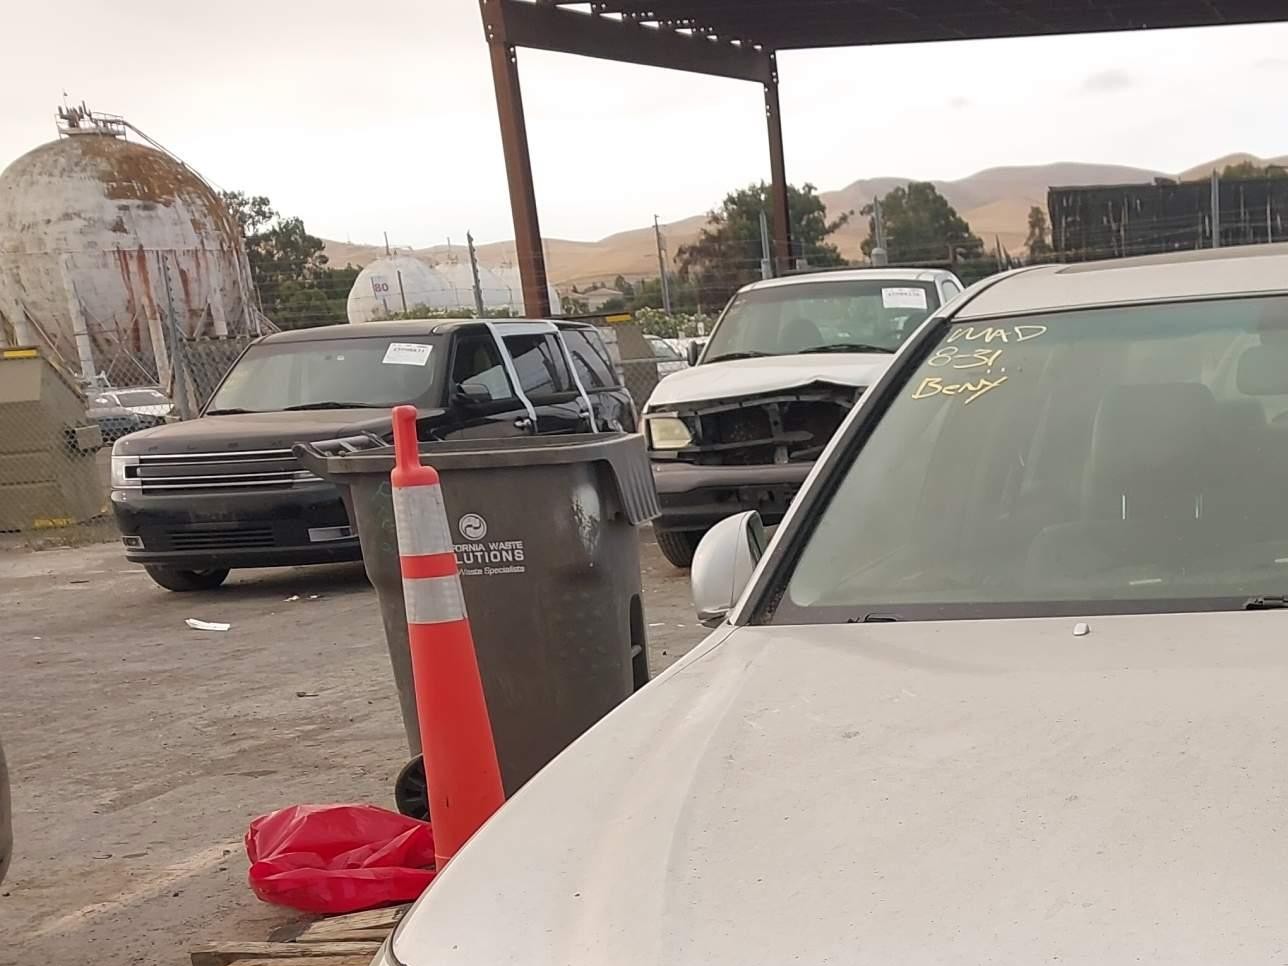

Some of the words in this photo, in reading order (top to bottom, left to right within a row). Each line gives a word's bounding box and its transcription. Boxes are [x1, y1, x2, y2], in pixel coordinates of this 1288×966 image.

[455, 543, 486, 552] ORNIA
[488, 541, 524, 550] WASTE
[456, 550, 524, 563] LUTIONS
